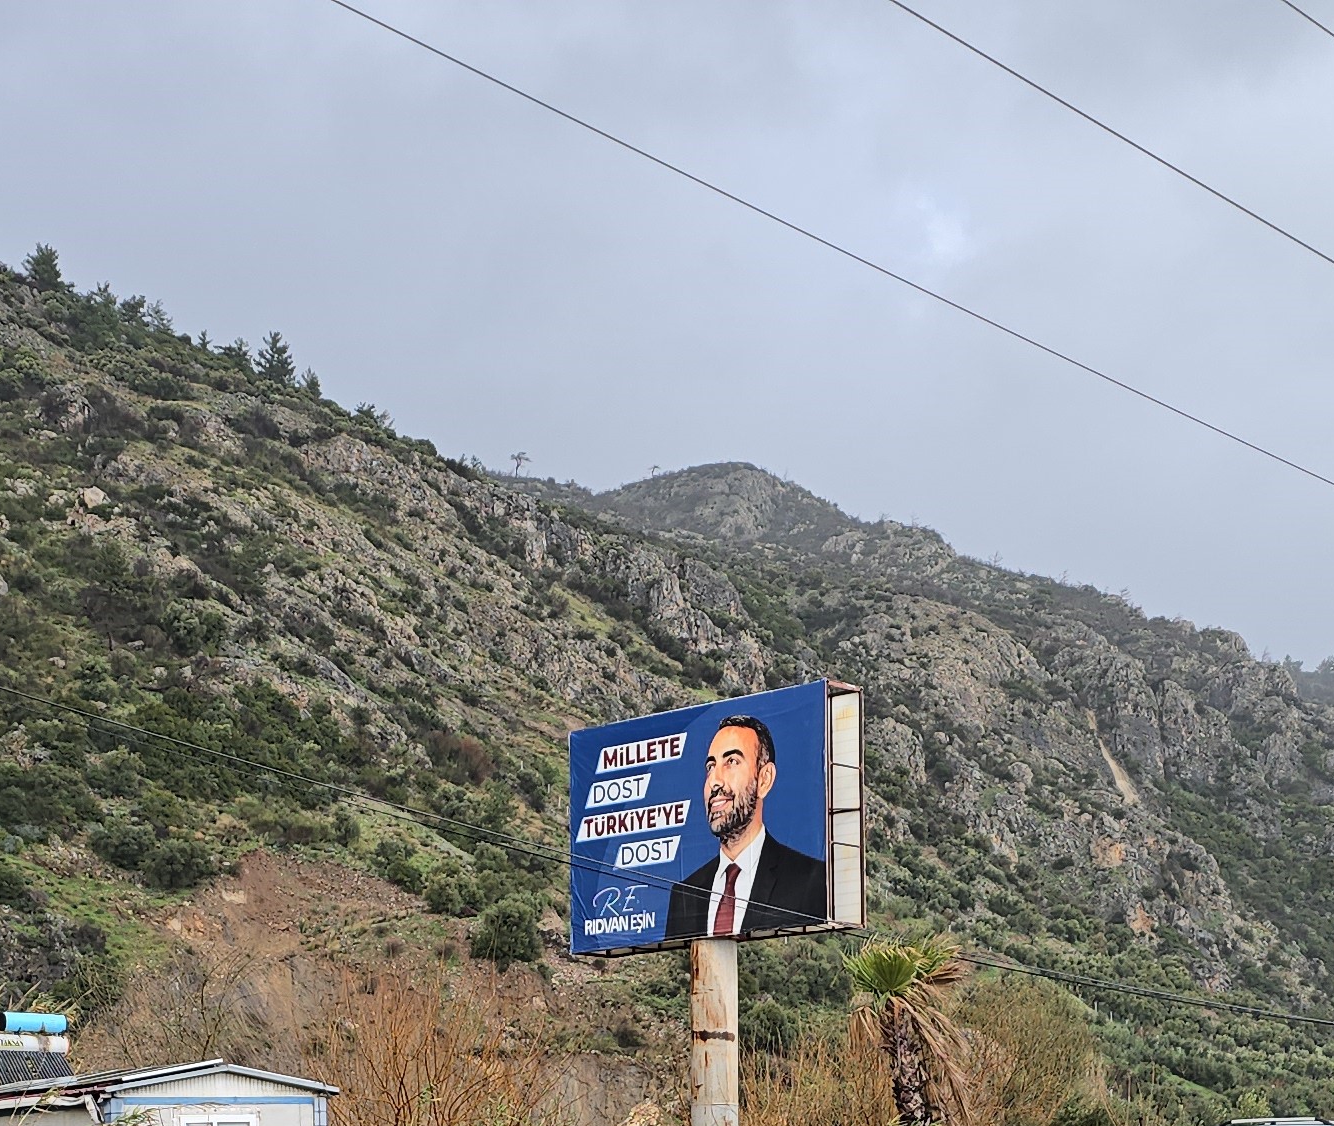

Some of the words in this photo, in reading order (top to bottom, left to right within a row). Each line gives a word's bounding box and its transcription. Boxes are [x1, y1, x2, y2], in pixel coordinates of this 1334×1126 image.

[603, 736, 681, 770] MİLLETE
[593, 777, 645, 804] DOST
[583, 803, 685, 838] TÜRKİYE'YE
[621, 840, 674, 866] DOST
[584, 915, 629, 936] RIDVAN
[630, 909, 656, 934] EŞİN
